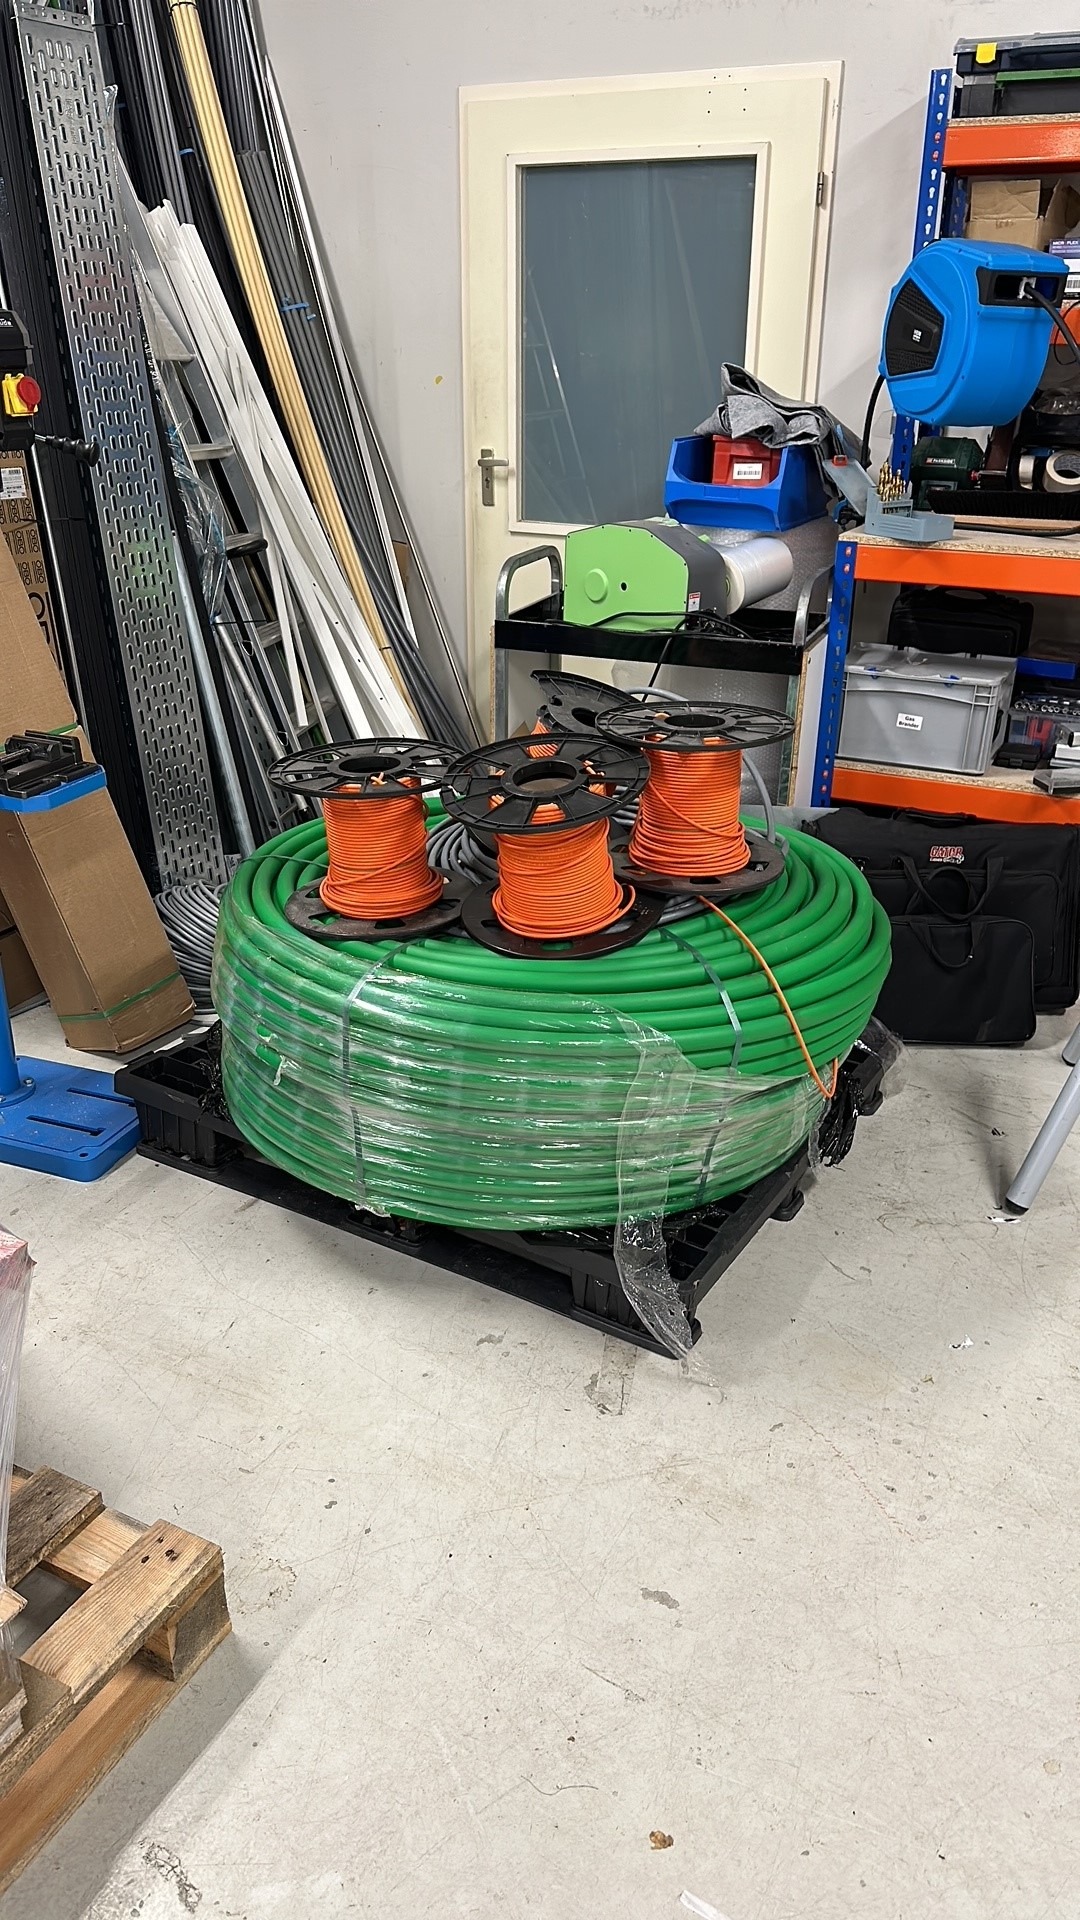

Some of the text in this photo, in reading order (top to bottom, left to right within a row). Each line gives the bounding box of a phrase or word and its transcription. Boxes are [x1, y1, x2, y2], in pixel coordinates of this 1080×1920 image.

[11, 499, 19, 523] OBO
[16, 530, 25, 555] OBO
[30, 529, 39, 553] OBO
[22, 561, 31, 586] OBO
[36, 560, 44, 584] OBO
[898, 720, 920, 728] Brander
[930, 845, 964, 858] GATOR
